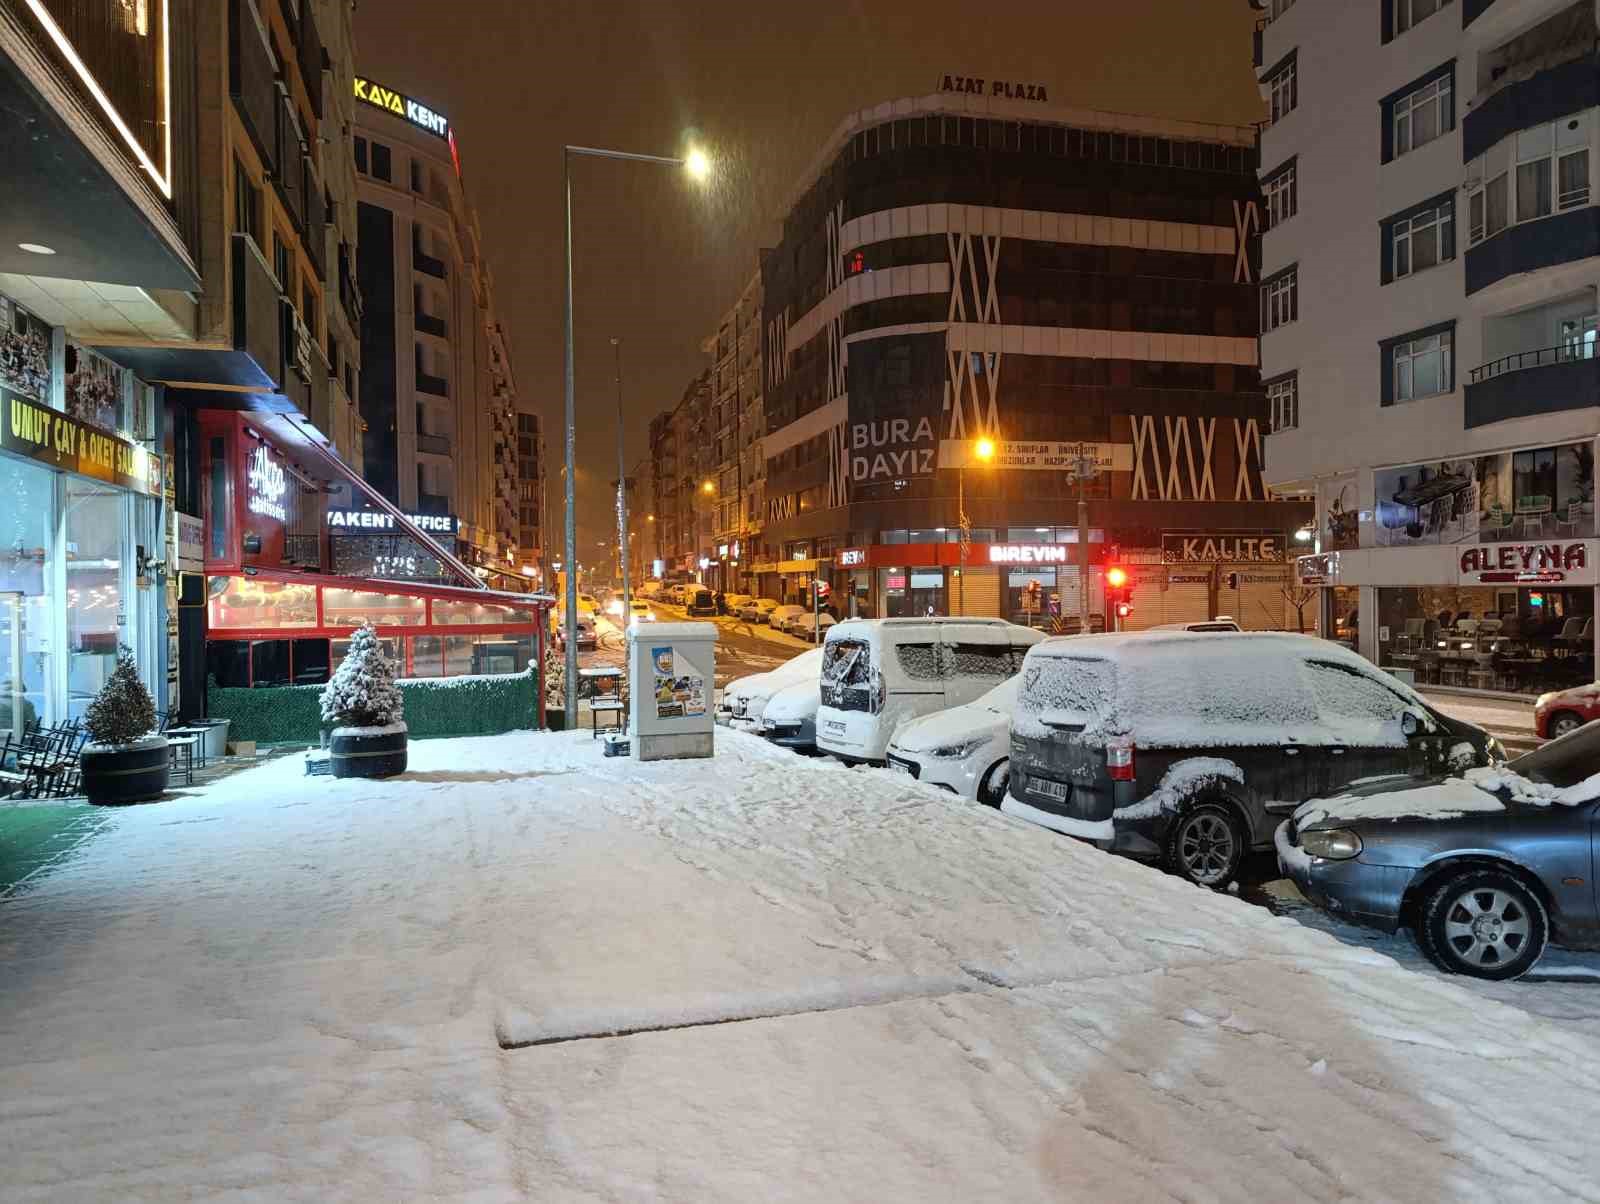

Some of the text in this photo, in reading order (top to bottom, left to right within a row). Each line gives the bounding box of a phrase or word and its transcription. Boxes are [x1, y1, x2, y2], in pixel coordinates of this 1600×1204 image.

[943, 75, 1048, 102] AZAT PLAZA
[353, 77, 448, 135] KAYA KENT
[11, 399, 51, 447] UMUT
[54, 417, 77, 462] ÇAY
[79, 428, 87, 459] &
[89, 432, 114, 469] OKEY
[853, 416, 934, 449] BURA
[1461, 543, 1585, 574] ALEYNA
